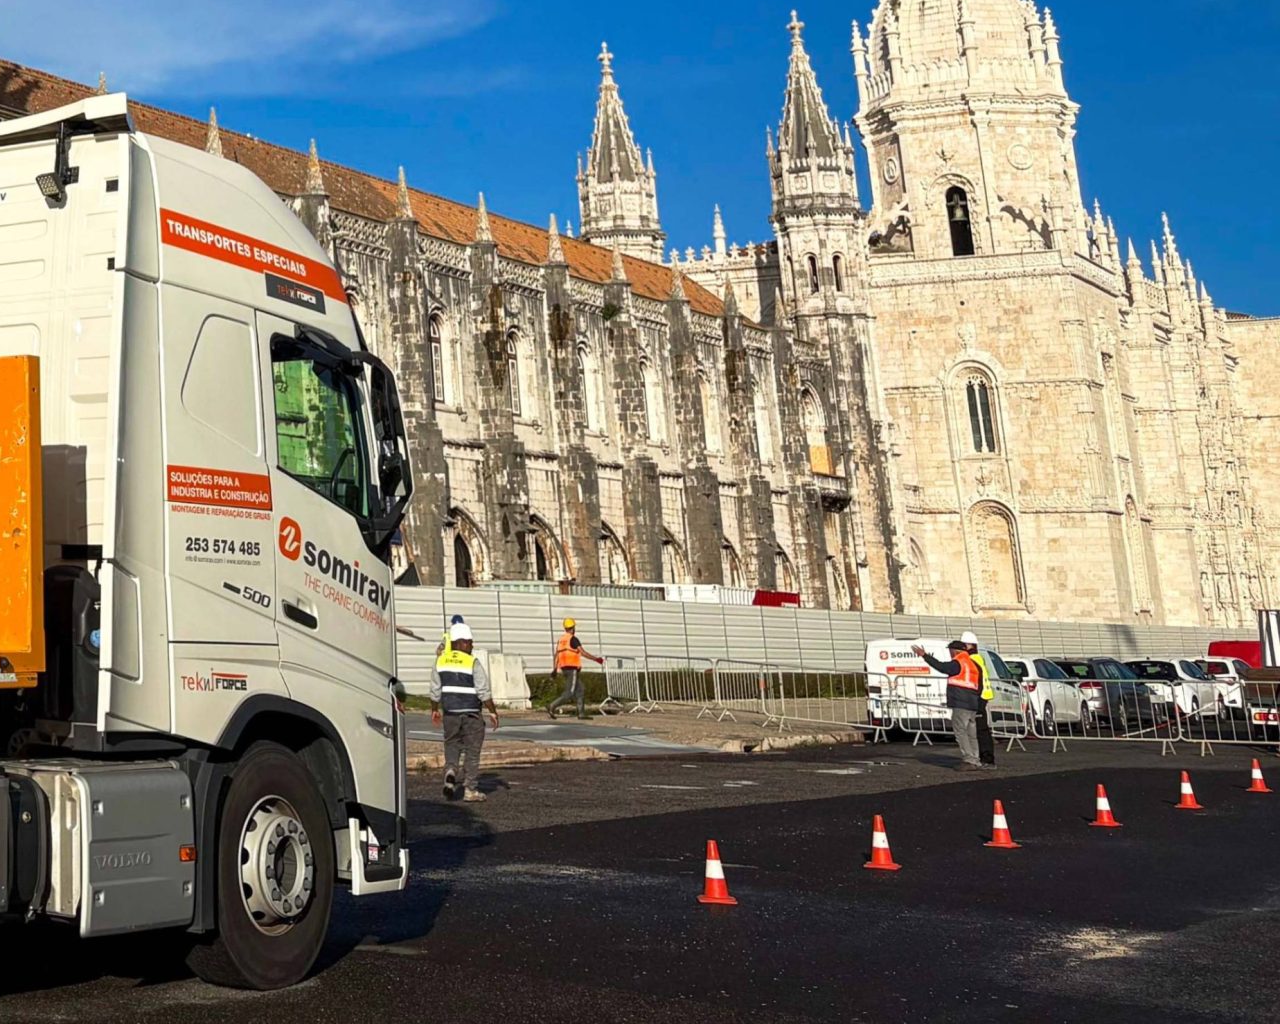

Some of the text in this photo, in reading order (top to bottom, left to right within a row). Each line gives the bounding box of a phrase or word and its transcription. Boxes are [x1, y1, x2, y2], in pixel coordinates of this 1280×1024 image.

[167, 219, 307, 277] TRANSPORTES ESPECIAIS
[170, 470, 240, 487] SOLUÇÕES PARA A
[214, 489, 220, 499] E
[220, 489, 269, 504] CONSTRUÇÃO
[171, 504, 206, 515] MONTAGEM
[245, 511, 253, 519] DE
[186, 537, 261, 556] 253 574 485
[303, 540, 390, 611] somirav
[242, 586, 271, 608] 500
[304, 571, 390, 632] THE CRANE COMPANY
[93, 851, 152, 869] VOLVO
